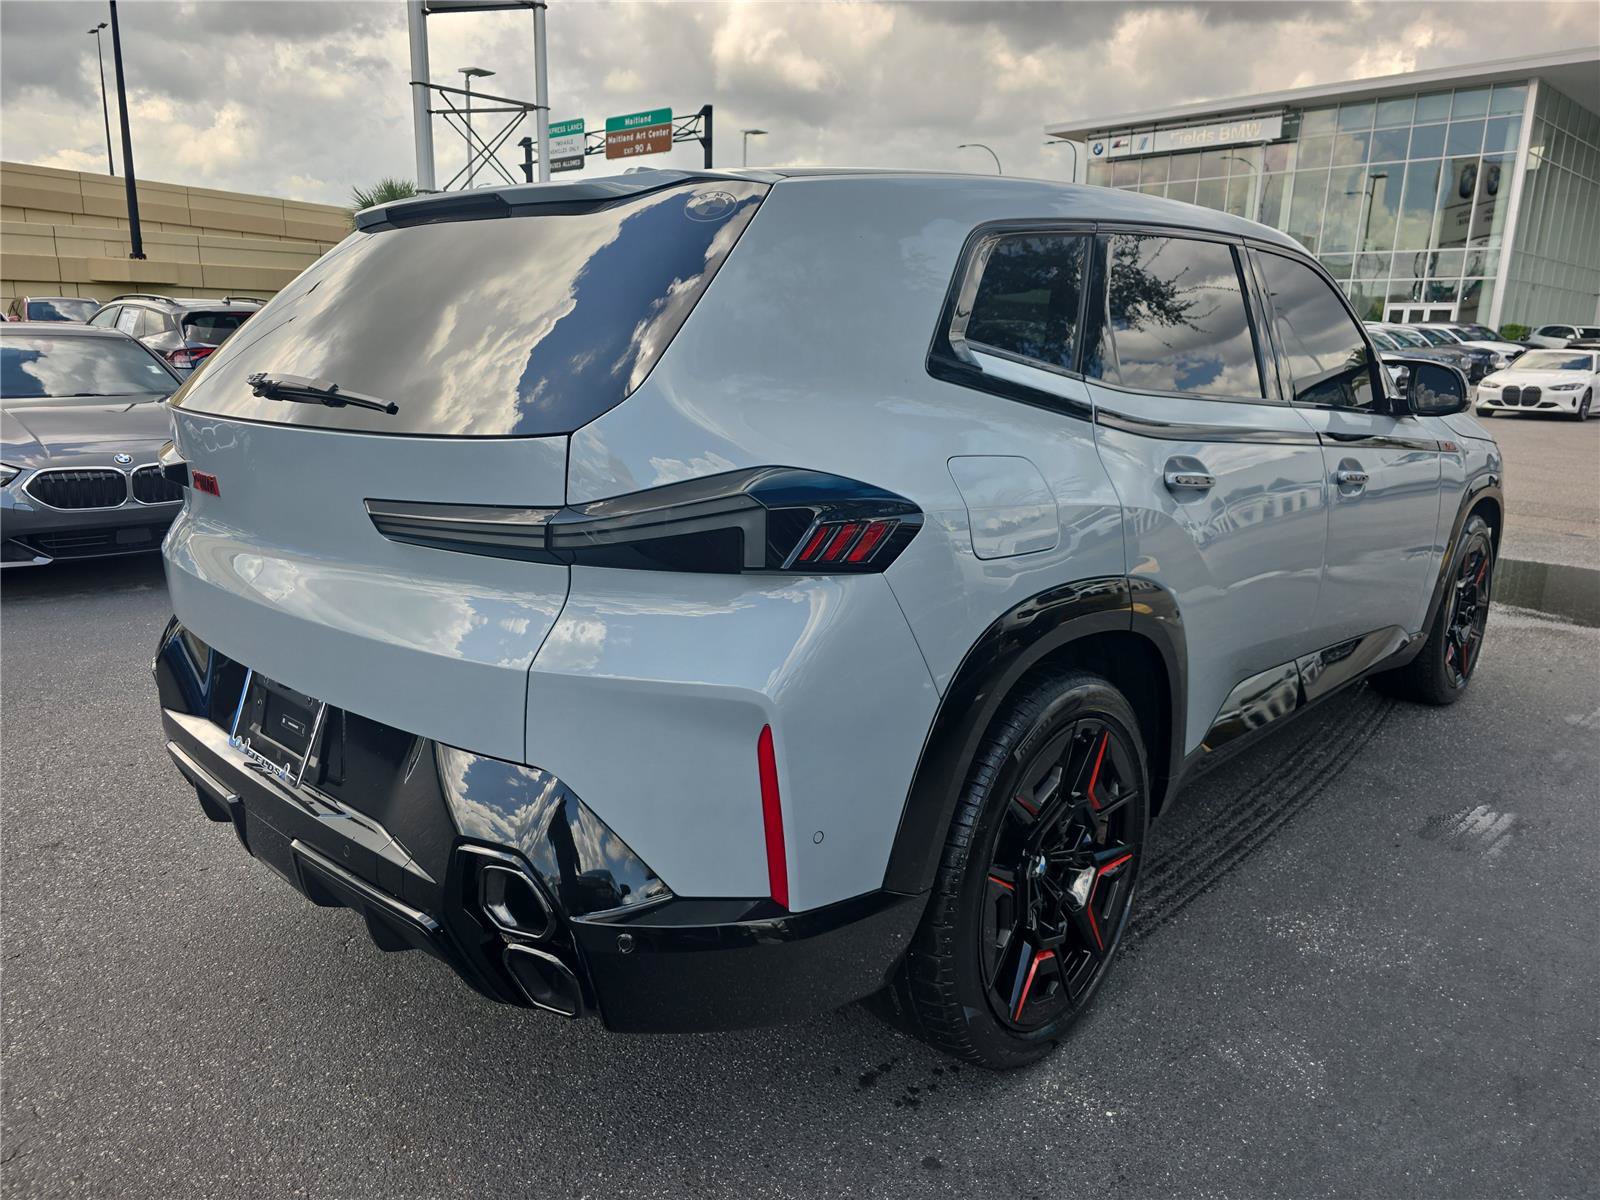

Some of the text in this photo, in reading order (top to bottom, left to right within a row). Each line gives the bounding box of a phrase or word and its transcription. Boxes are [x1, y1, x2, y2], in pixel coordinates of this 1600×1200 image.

[624, 114, 652, 126] Maitland
[607, 128, 670, 144] Maitland Art Center
[1170, 122, 1263, 145] Fields BMW
[634, 144, 644, 153] 90
[646, 143, 652, 152] A
[247, 749, 281, 776] FIELDS
